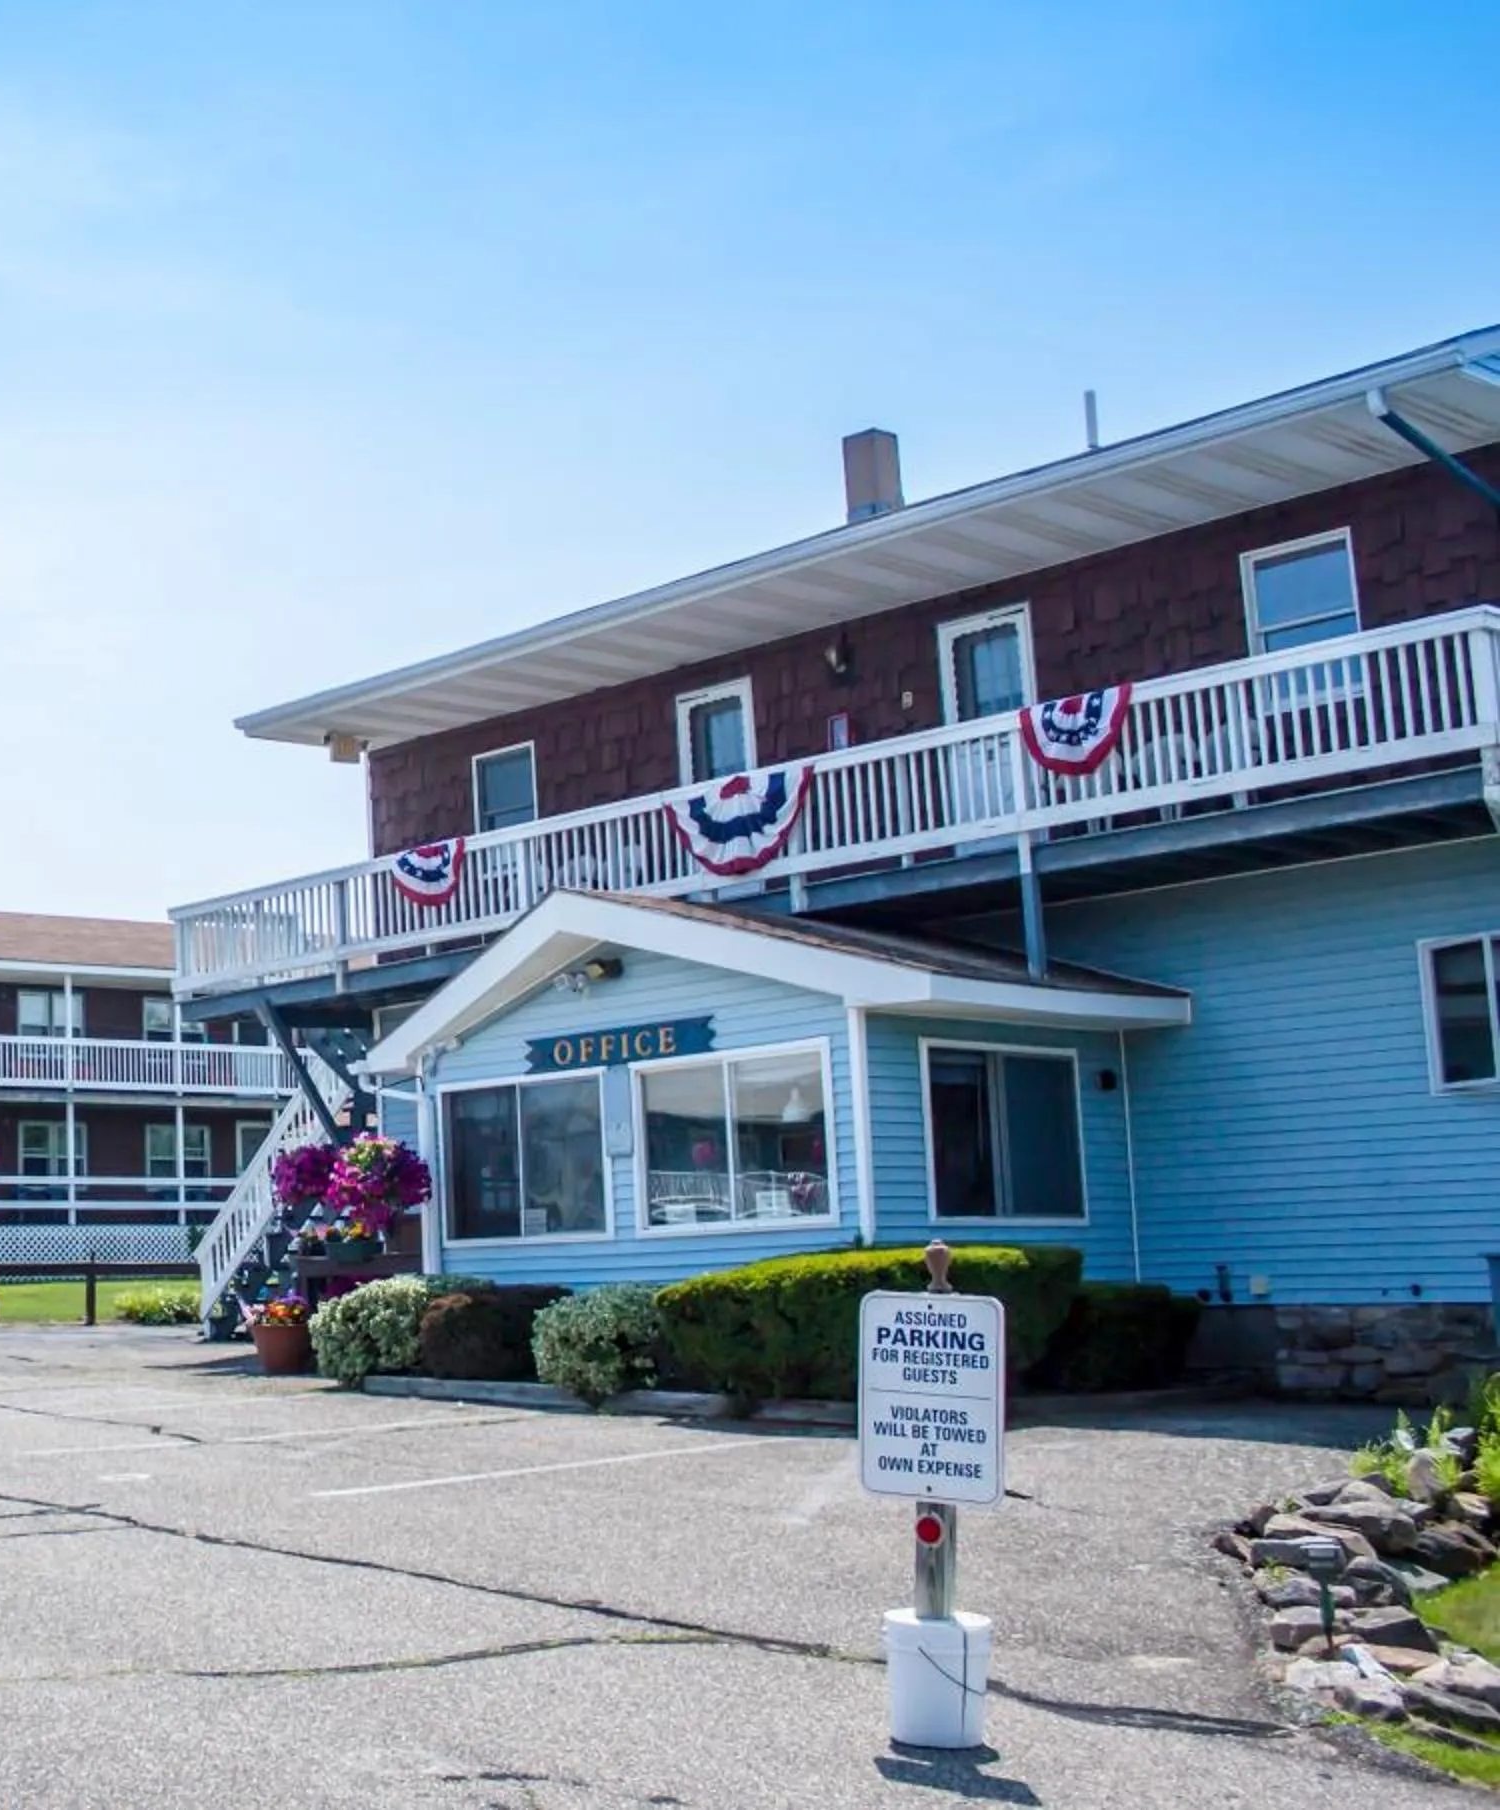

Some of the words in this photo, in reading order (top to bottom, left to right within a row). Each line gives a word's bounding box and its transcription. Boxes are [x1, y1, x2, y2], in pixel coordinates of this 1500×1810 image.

[553, 1027, 677, 1065] OFFICE
[894, 1311, 967, 1329] ASSIGNED
[876, 1327, 985, 1351] PARKING
[872, 1347, 899, 1363] FOR
[903, 1350, 989, 1369] REGISTERED
[903, 1367, 958, 1385] GUESTS
[891, 1405, 968, 1425] VIOLATORS
[873, 1422, 907, 1438] WILL
[911, 1425, 929, 1439] BE
[935, 1427, 987, 1444] TOWED
[920, 1443, 938, 1457] AT
[878, 1456, 913, 1472] OWN
[917, 1461, 982, 1479] EXPENSE
